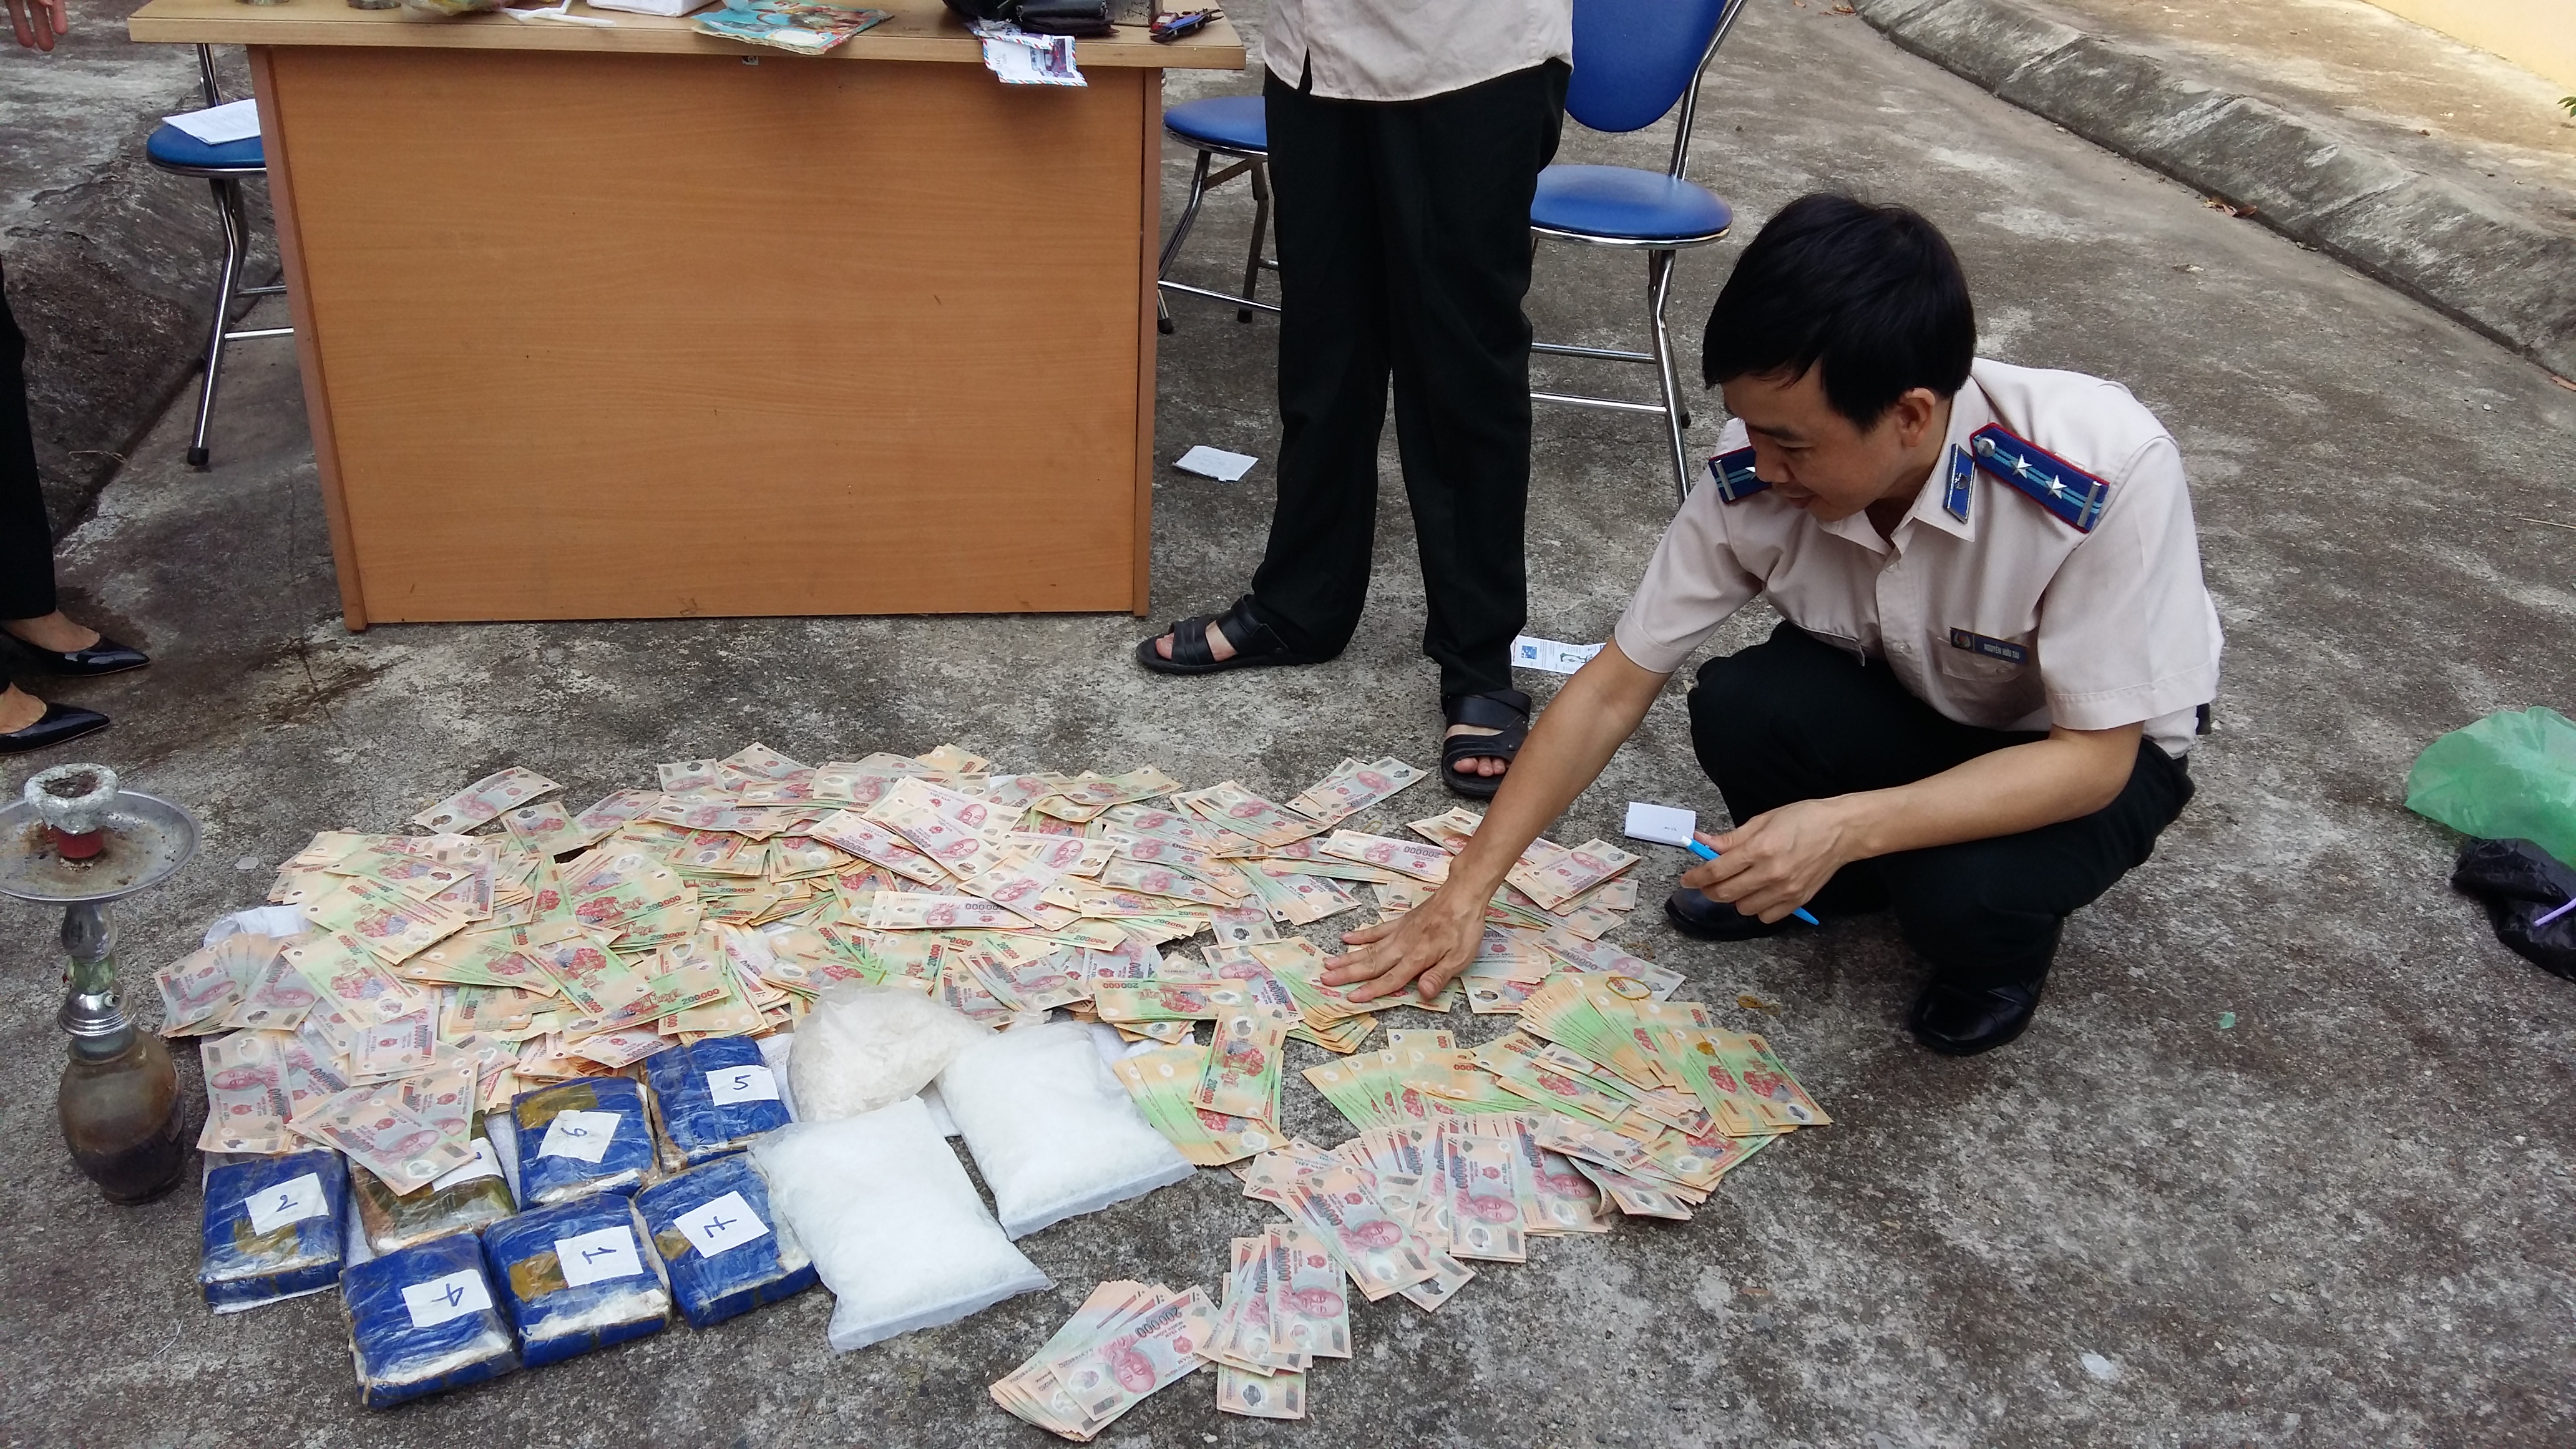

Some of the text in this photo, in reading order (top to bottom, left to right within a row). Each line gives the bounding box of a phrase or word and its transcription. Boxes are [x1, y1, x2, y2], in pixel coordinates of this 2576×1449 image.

[1348, 793, 1377, 807] 200000
[837, 837, 870, 854] 200000
[1404, 846, 1441, 858] 200000
[646, 895, 681, 912] 200000
[1154, 918, 1187, 929] 200000
[650, 930, 686, 940] 200000
[818, 927, 841, 946] 200000
[1073, 934, 1107, 944] 200000
[338, 935, 363, 955] 200000
[997, 942, 1020, 959] 200000
[927, 944, 941, 967] 200000
[1561, 950, 1598, 970] 200000
[1128, 962, 1141, 978] 0000
[681, 988, 720, 1005] 200000
[1267, 980, 1288, 1005] 200000
[577, 992, 604, 1013] 200000
[414, 1024, 429, 1049] 200000
[627, 1041, 664, 1059] 200000
[733, 1074, 751, 1091] 5
[1202, 1078, 1217, 1104] 200000
[1453, 1156, 1468, 1189] 200000
[276, 1194, 298, 1212] 2
[1310, 1193, 1343, 1226] 200000
[703, 1216, 738, 1239] 7
[582, 1247, 617, 1265] 1
[1276, 1247, 1292, 1281] 200000
[431, 1284, 464, 1307] 4
[1135, 1305, 1183, 1338] 200000
